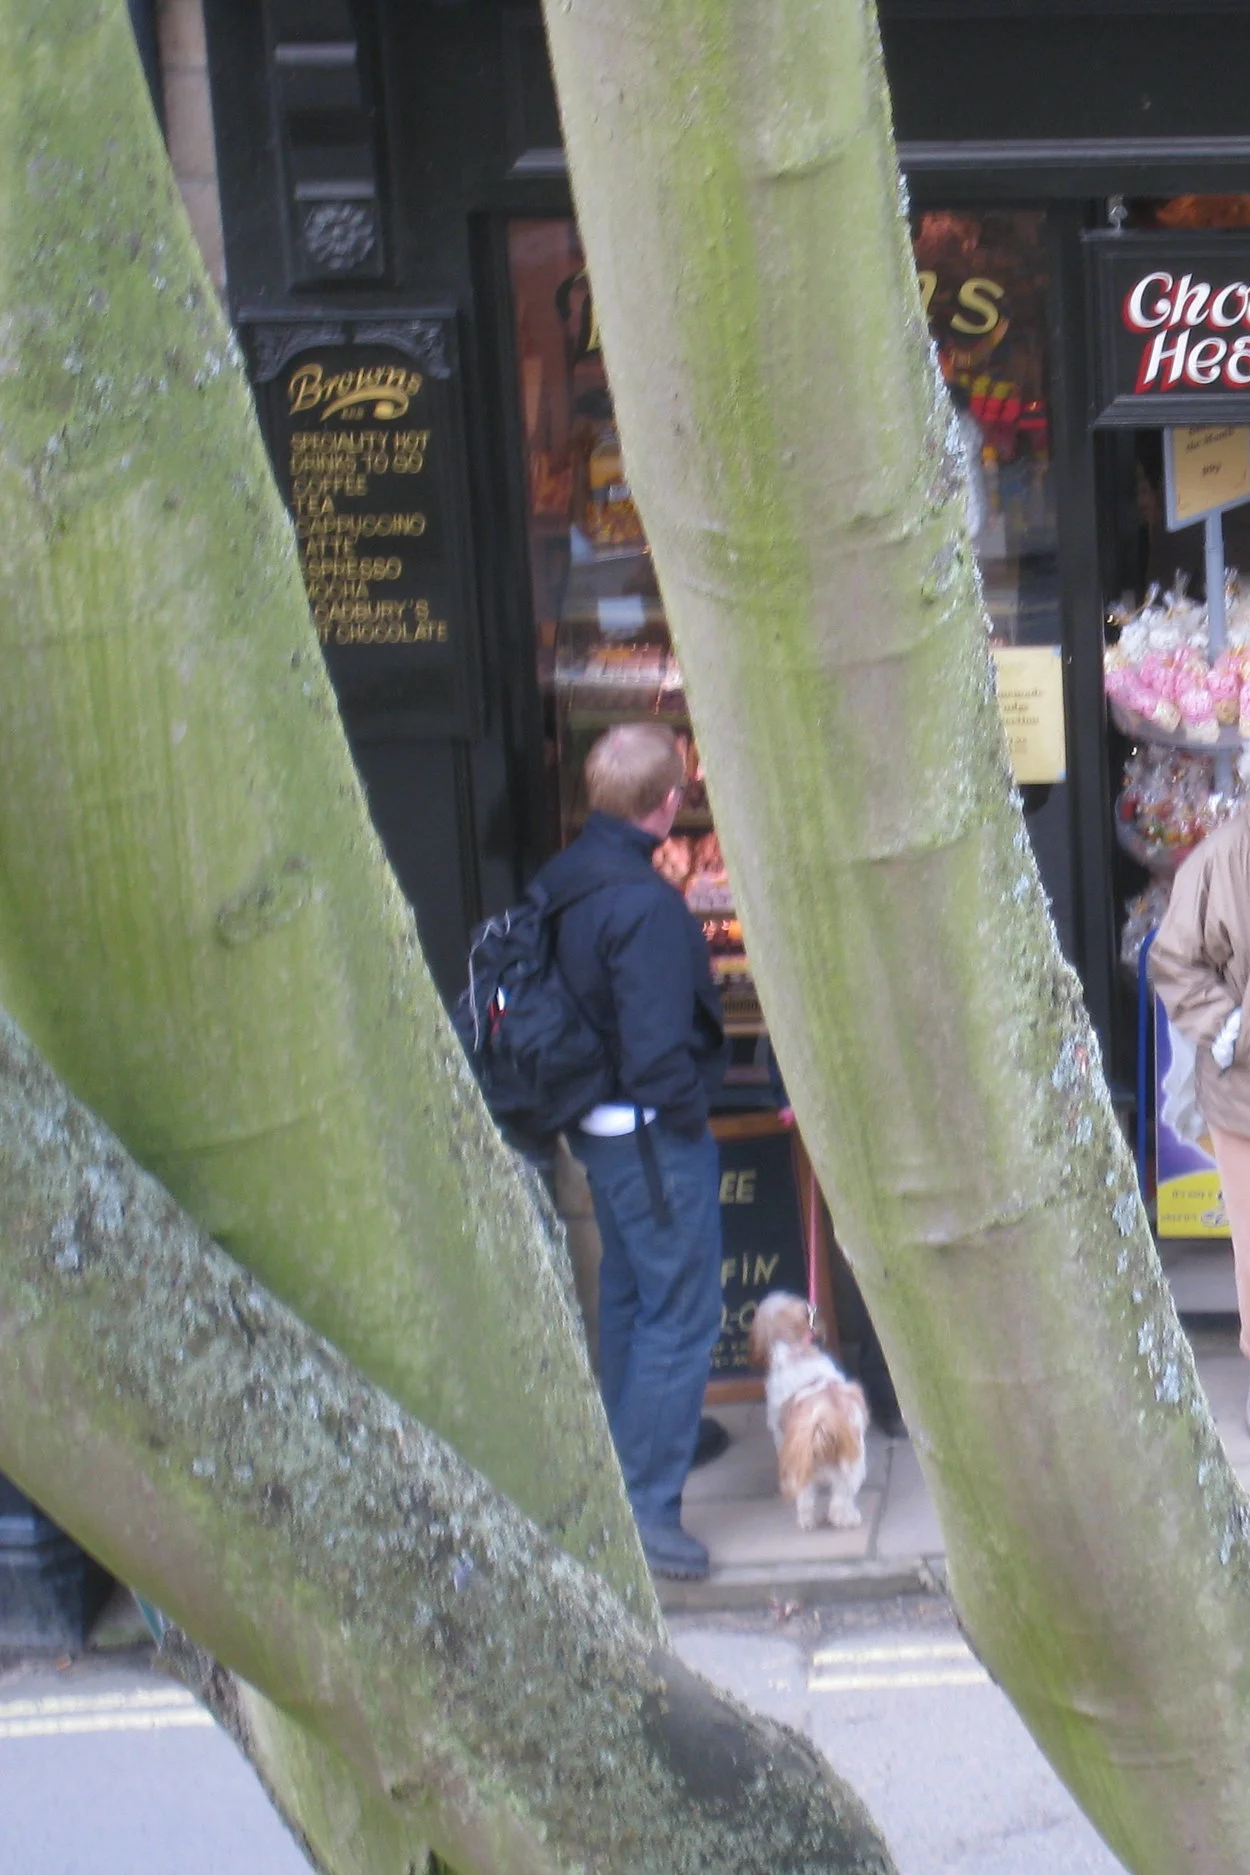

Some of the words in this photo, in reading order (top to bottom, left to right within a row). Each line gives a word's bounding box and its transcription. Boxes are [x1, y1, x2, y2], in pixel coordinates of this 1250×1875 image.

[288, 362, 423, 416] Browns
[361, 452, 389, 474] TO
[293, 474, 367, 496] COFFEE
[294, 495, 335, 517] TEA
[307, 556, 402, 581] SPRESSO
